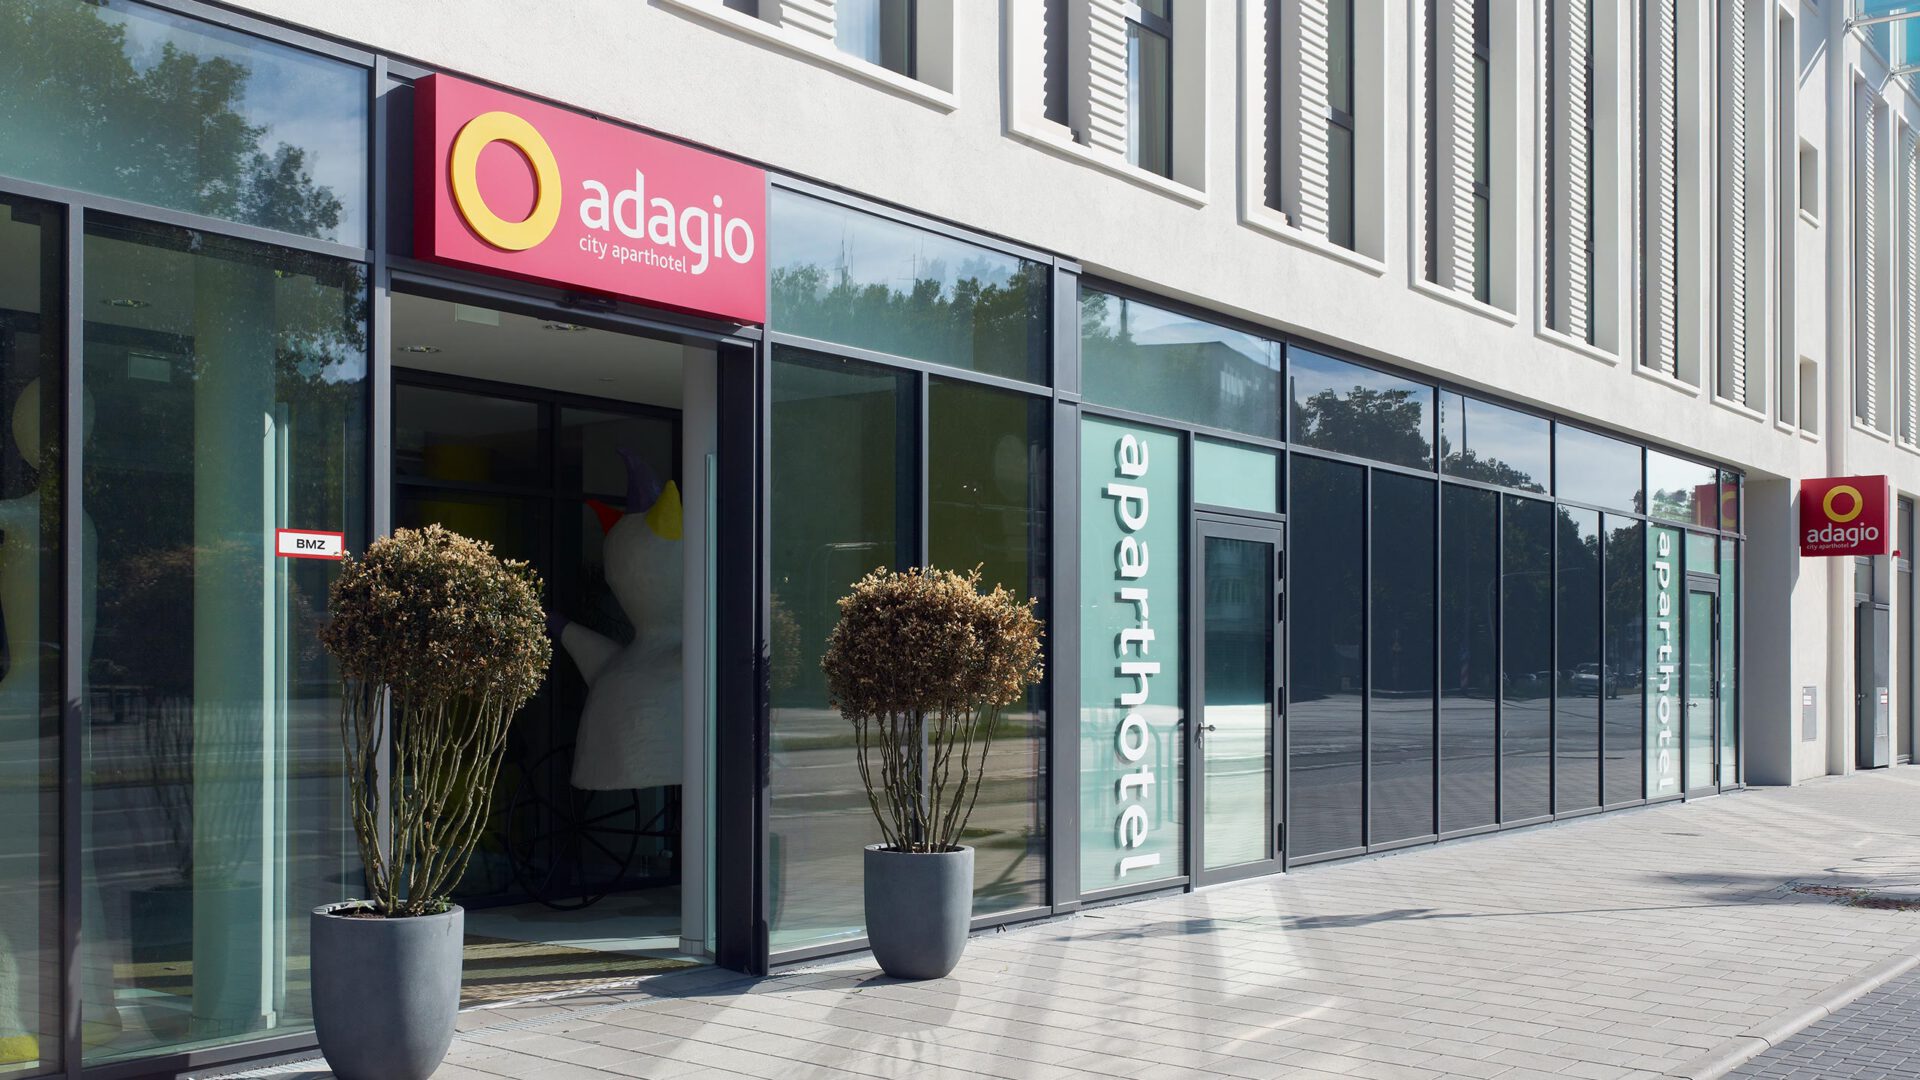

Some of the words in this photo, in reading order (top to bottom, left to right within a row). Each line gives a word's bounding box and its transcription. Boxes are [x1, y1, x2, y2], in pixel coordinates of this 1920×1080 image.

[579, 168, 755, 275] adagio
[579, 235, 608, 260] city
[612, 244, 687, 273] aparthotel
[296, 538, 326, 550] BMZ
[1806, 522, 1879, 547] adagio
[1819, 542, 1849, 550] aparthotel
[1107, 433, 1160, 877] aparthotel
[1655, 532, 1674, 791] aparthotel
